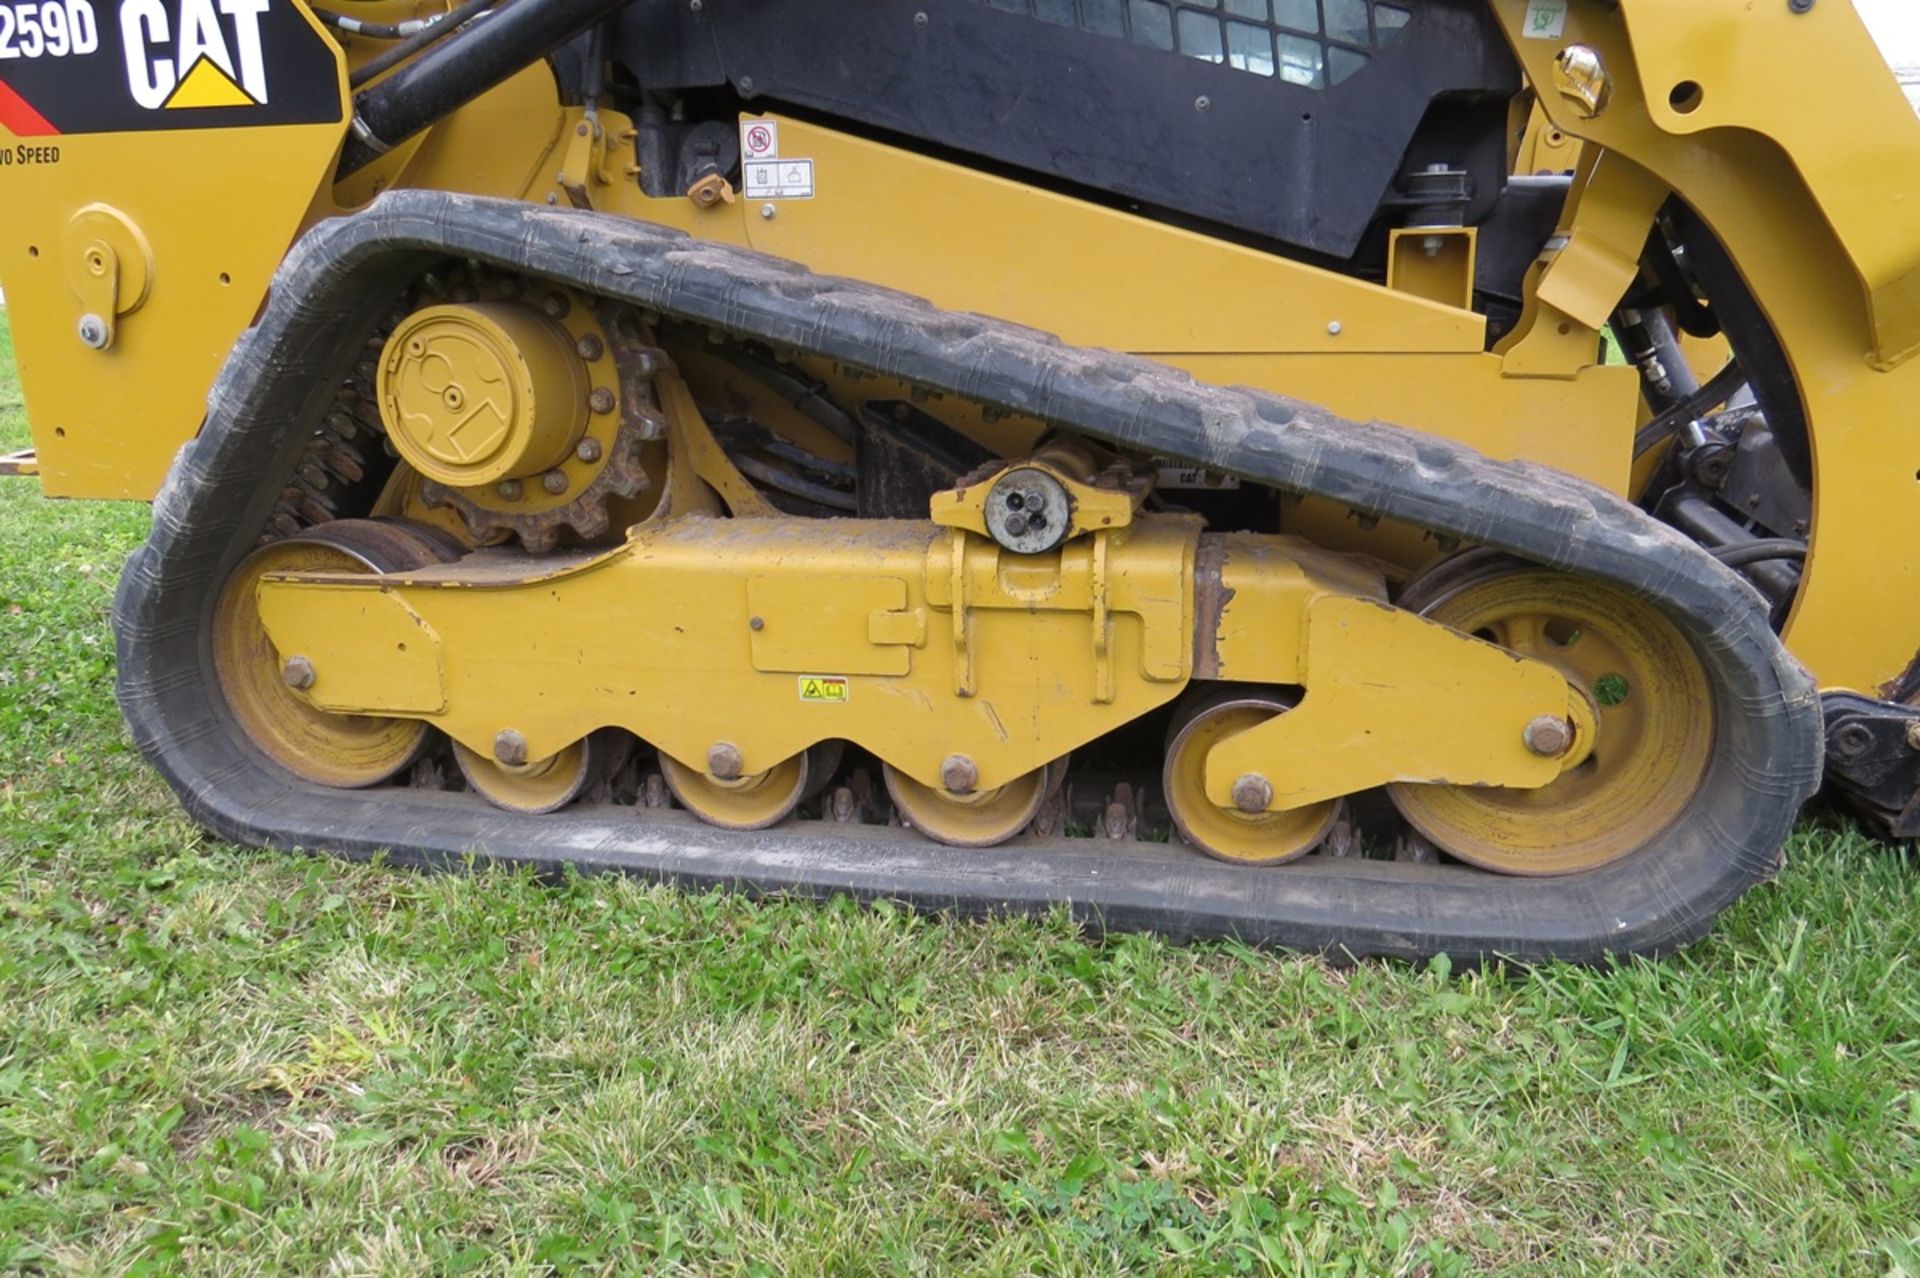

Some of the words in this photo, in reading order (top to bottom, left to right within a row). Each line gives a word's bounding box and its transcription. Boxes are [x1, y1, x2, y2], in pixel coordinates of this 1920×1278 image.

[0, 0, 98, 59] 259D
[119, 0, 270, 109] CAT
[17, 145, 60, 164] SPEED
